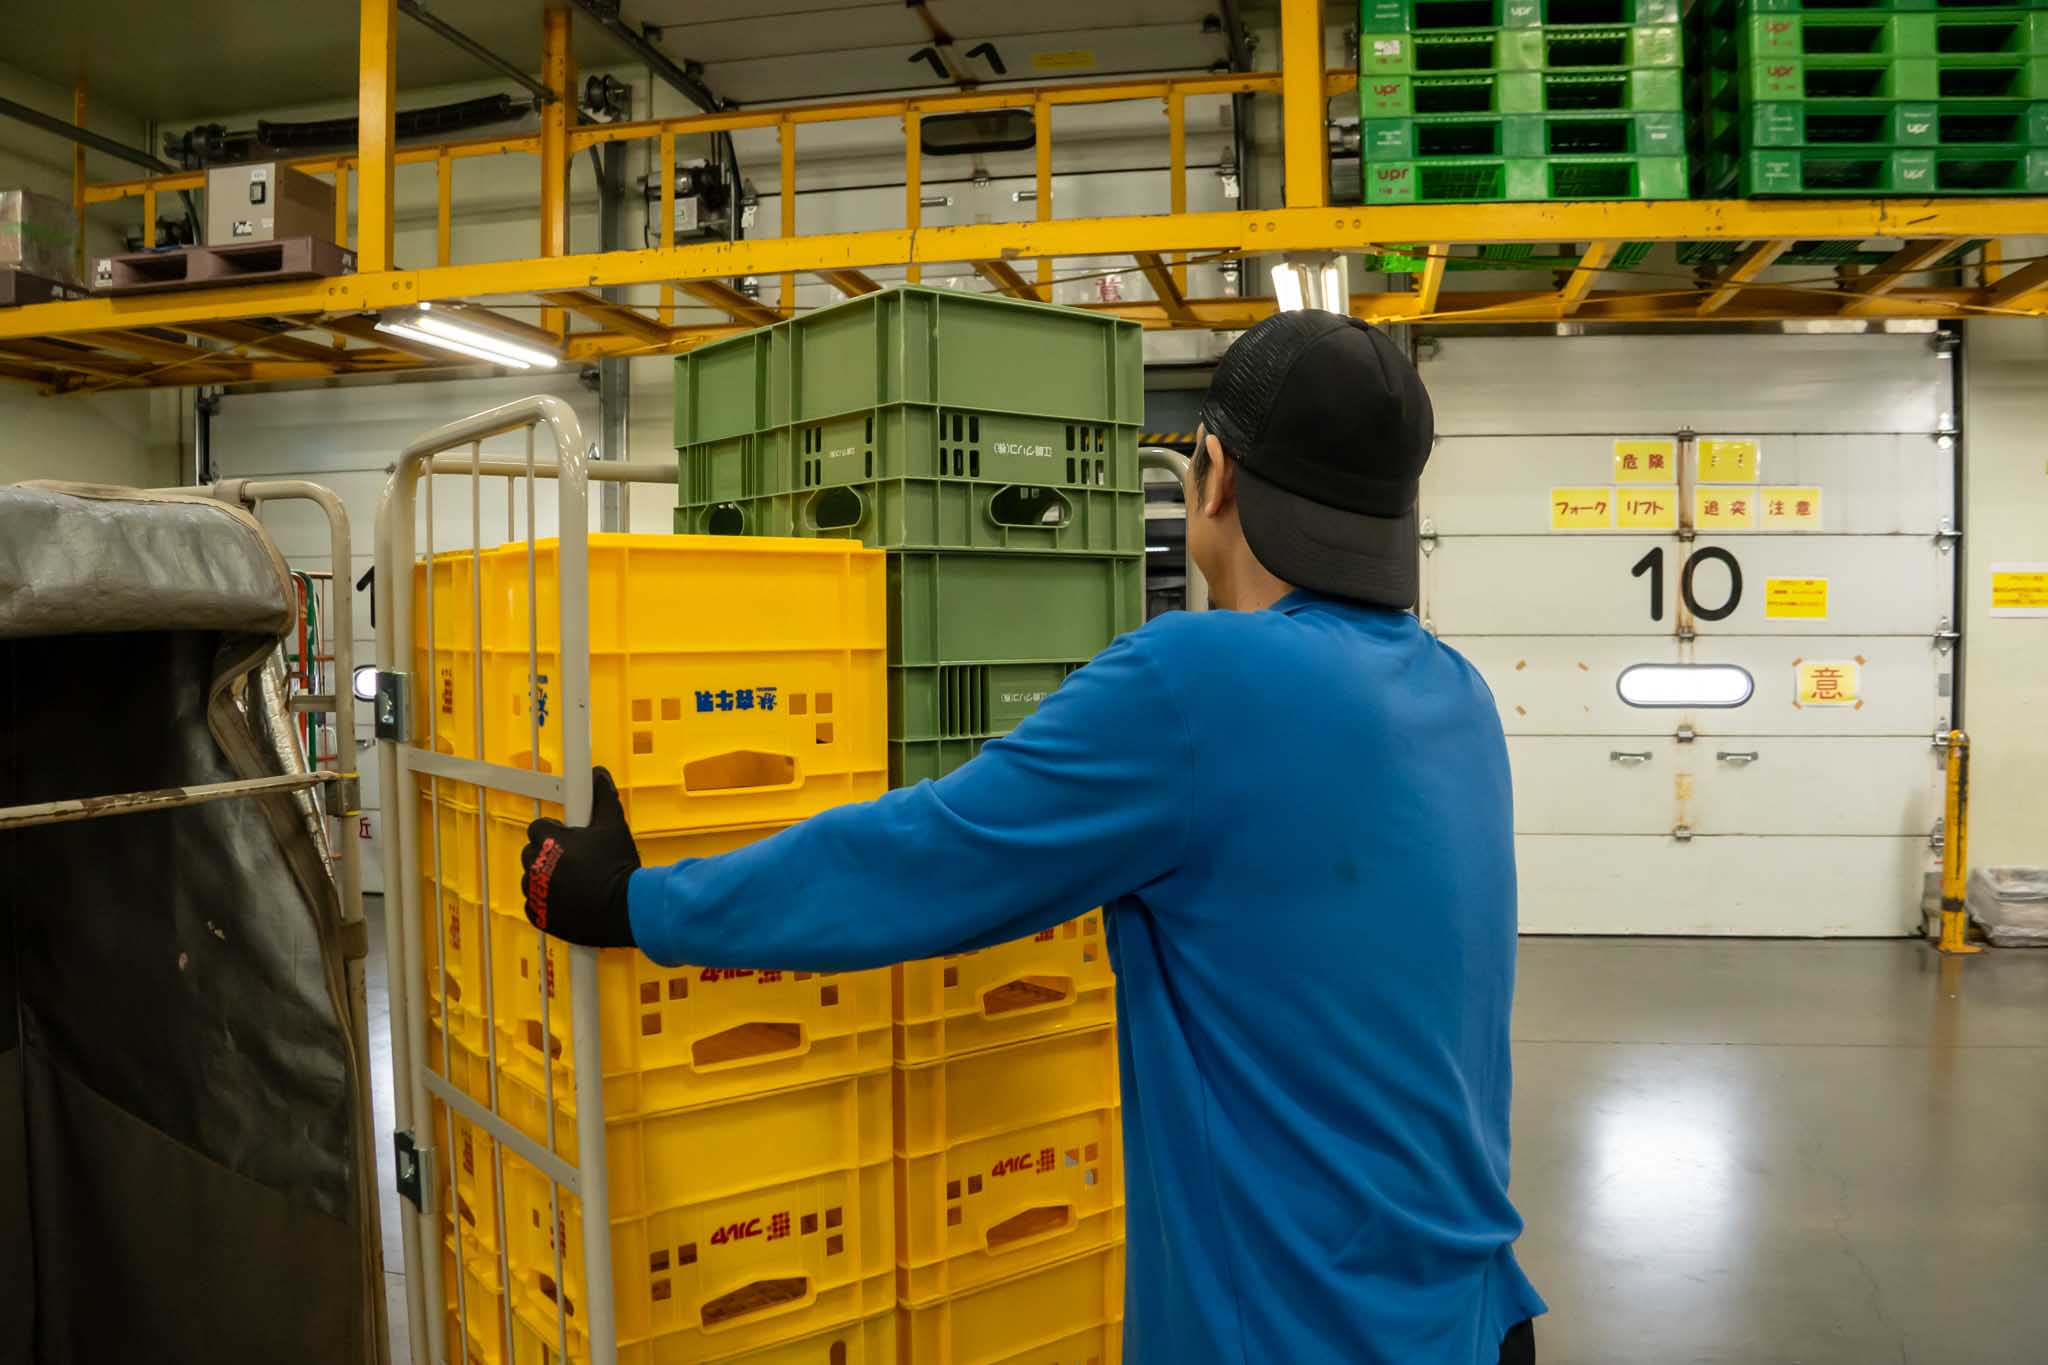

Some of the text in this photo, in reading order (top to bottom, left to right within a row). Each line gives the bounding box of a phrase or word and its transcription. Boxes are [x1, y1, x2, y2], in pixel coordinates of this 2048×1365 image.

[1377, 167, 1409, 181] upr
[1555, 501, 1607, 515] フォーク
[1626, 500, 1664, 516] リフト
[1631, 546, 1743, 622] 10
[1811, 667, 1844, 700] 意
[991, 1152, 1033, 1177] フルヤ
[710, 1218, 763, 1246] フルヤ
